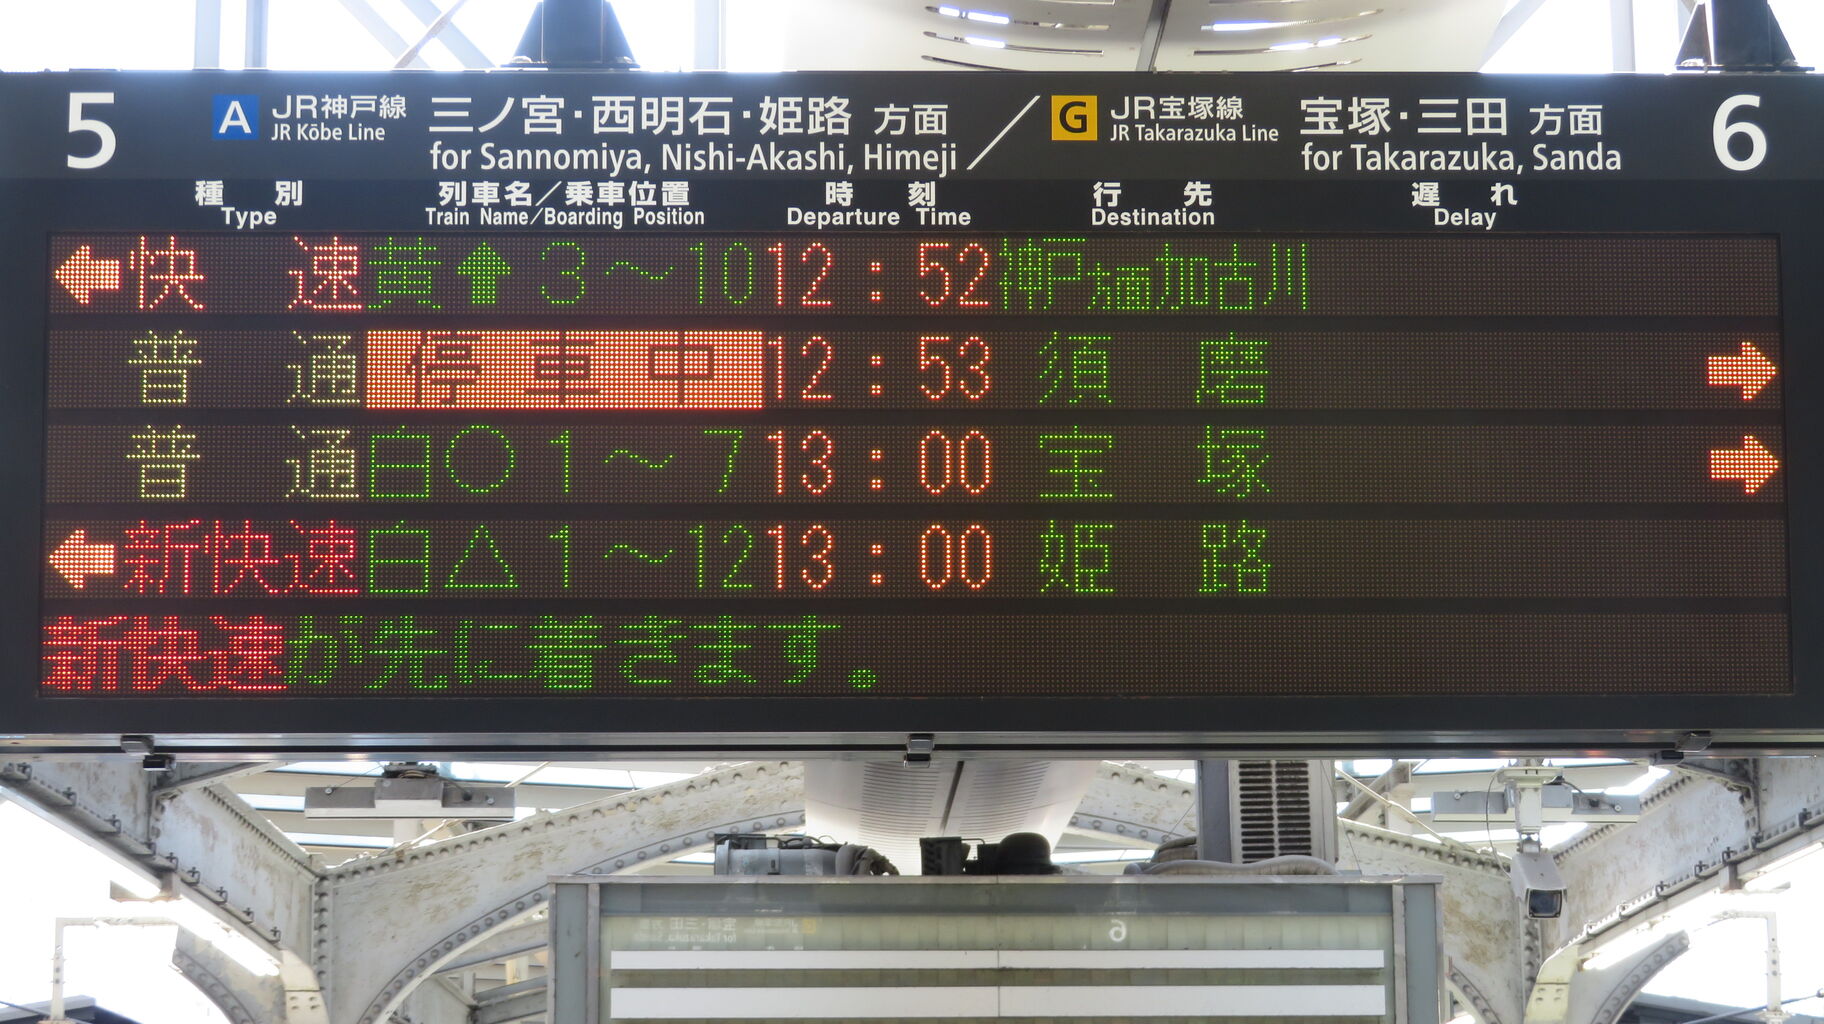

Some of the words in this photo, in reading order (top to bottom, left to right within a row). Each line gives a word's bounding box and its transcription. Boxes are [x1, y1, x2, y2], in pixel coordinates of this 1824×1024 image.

[218, 100, 252, 134] A
[271, 94, 407, 120] JR神戸線
[873, 103, 949, 137] 方面
[1057, 100, 1089, 134] G
[1110, 95, 1244, 121] JR宝塚線
[1529, 103, 1603, 137] 方面
[66, 91, 117, 170] 5
[270, 123, 291, 141] JR
[297, 122, 343, 141] Kōbe
[349, 123, 386, 141] Line
[1109, 124, 1130, 142] JR
[1135, 122, 1236, 142] Takarazuka
[1242, 123, 1279, 142] Line
[1712, 94, 1768, 172] 6
[429, 141, 472, 171] for
[480, 142, 651, 178] Sannomiya,
[661, 142, 854, 176] Nishi-Akashi,
[864, 143, 958, 178] Himeji
[1301, 141, 1342, 171] for
[1350, 142, 1524, 175] Takarazuka,
[1532, 142, 1622, 171] Sanda
[221, 206, 277, 230] Type
[425, 207, 470, 226] Train
[633, 206, 705, 226] Position
[787, 207, 901, 230] Departure
[916, 207, 972, 226] Time
[1092, 206, 1216, 227] Destination
[1434, 207, 1497, 231] Delay
[407, 332, 715, 406] 停車中
[122, 519, 360, 595] 新快速
